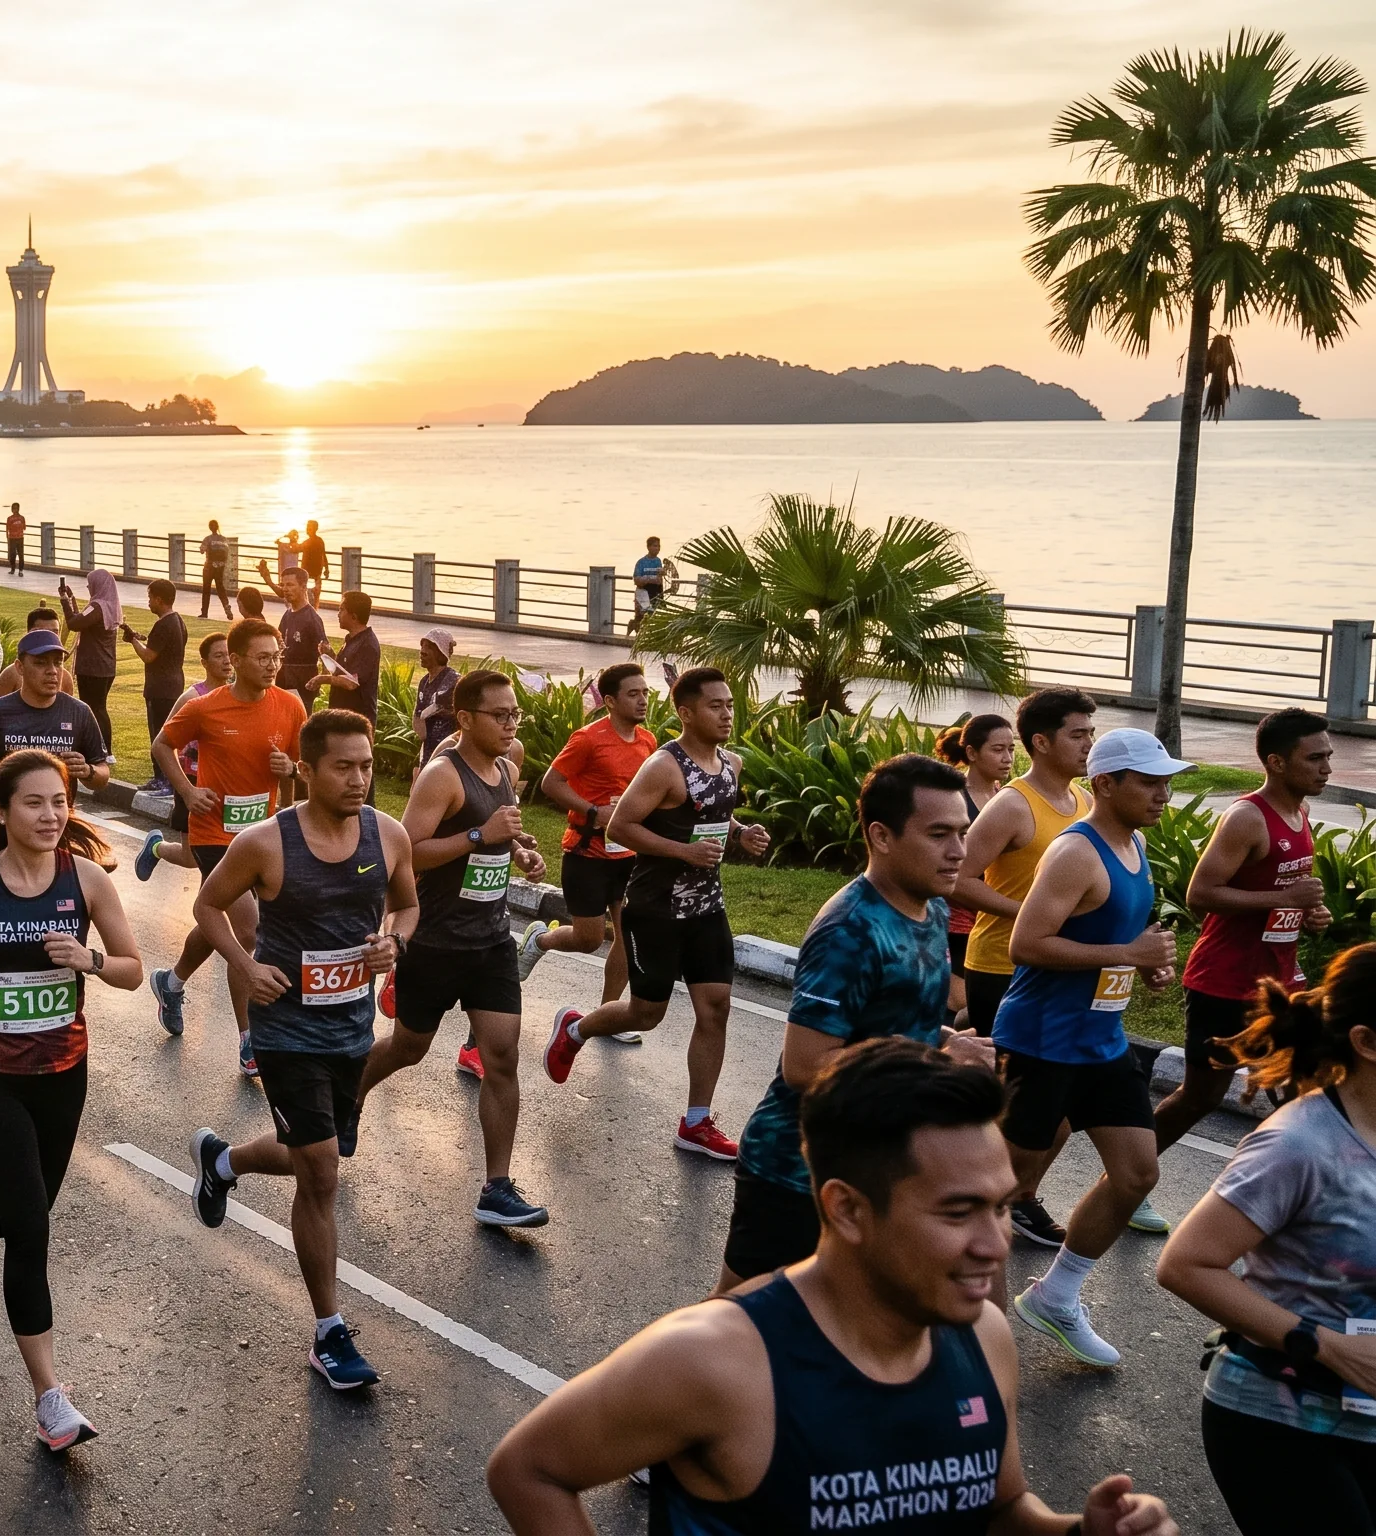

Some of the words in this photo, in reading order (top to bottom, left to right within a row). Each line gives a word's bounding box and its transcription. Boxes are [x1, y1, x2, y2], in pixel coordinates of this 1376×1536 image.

[17, 918, 79, 932] KINABALU
[309, 962, 364, 991] 3671
[4, 986, 69, 1015] 5102
[810, 1470, 880, 1501] KOTA
[885, 1448, 998, 1491] KINABALU
[810, 1489, 948, 1530] MARATHON
